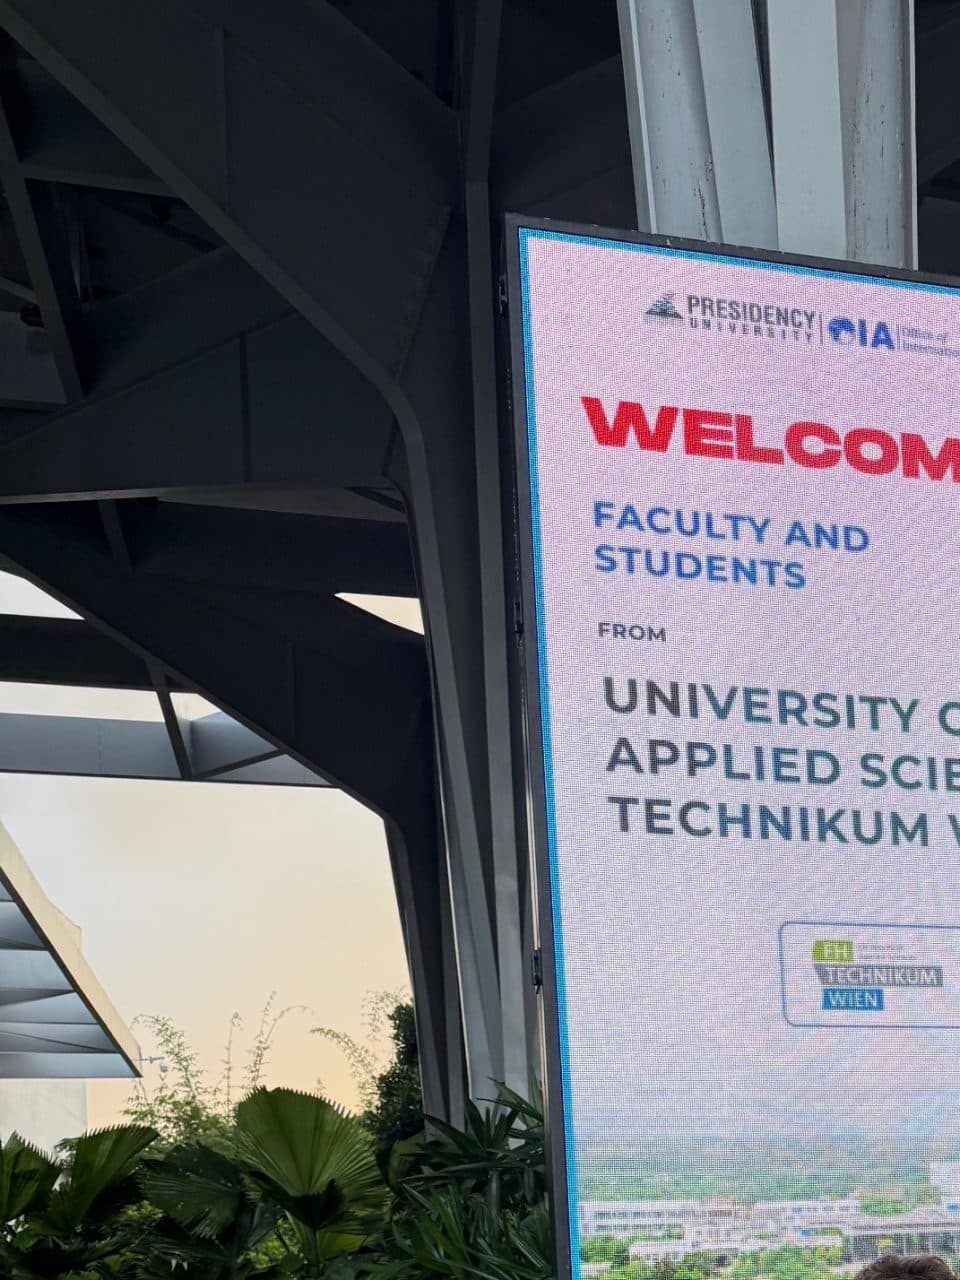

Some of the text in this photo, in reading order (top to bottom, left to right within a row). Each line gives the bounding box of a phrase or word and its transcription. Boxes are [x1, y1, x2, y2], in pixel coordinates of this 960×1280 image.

[687, 294, 816, 330] PRESIDENCY
[689, 317, 813, 343] UNIVERSITY
[593, 500, 870, 553] FACULTY AND
[593, 544, 807, 590] STUDENTS
[597, 621, 667, 643] FROM
[603, 676, 920, 733] UNIVERSITY
[606, 737, 841, 786] APPLIED
[607, 796, 930, 847] TECHNIKUM
[823, 942, 849, 960] FH
[826, 967, 938, 986] TECHNIKUM
[828, 990, 879, 1008] WIEN
